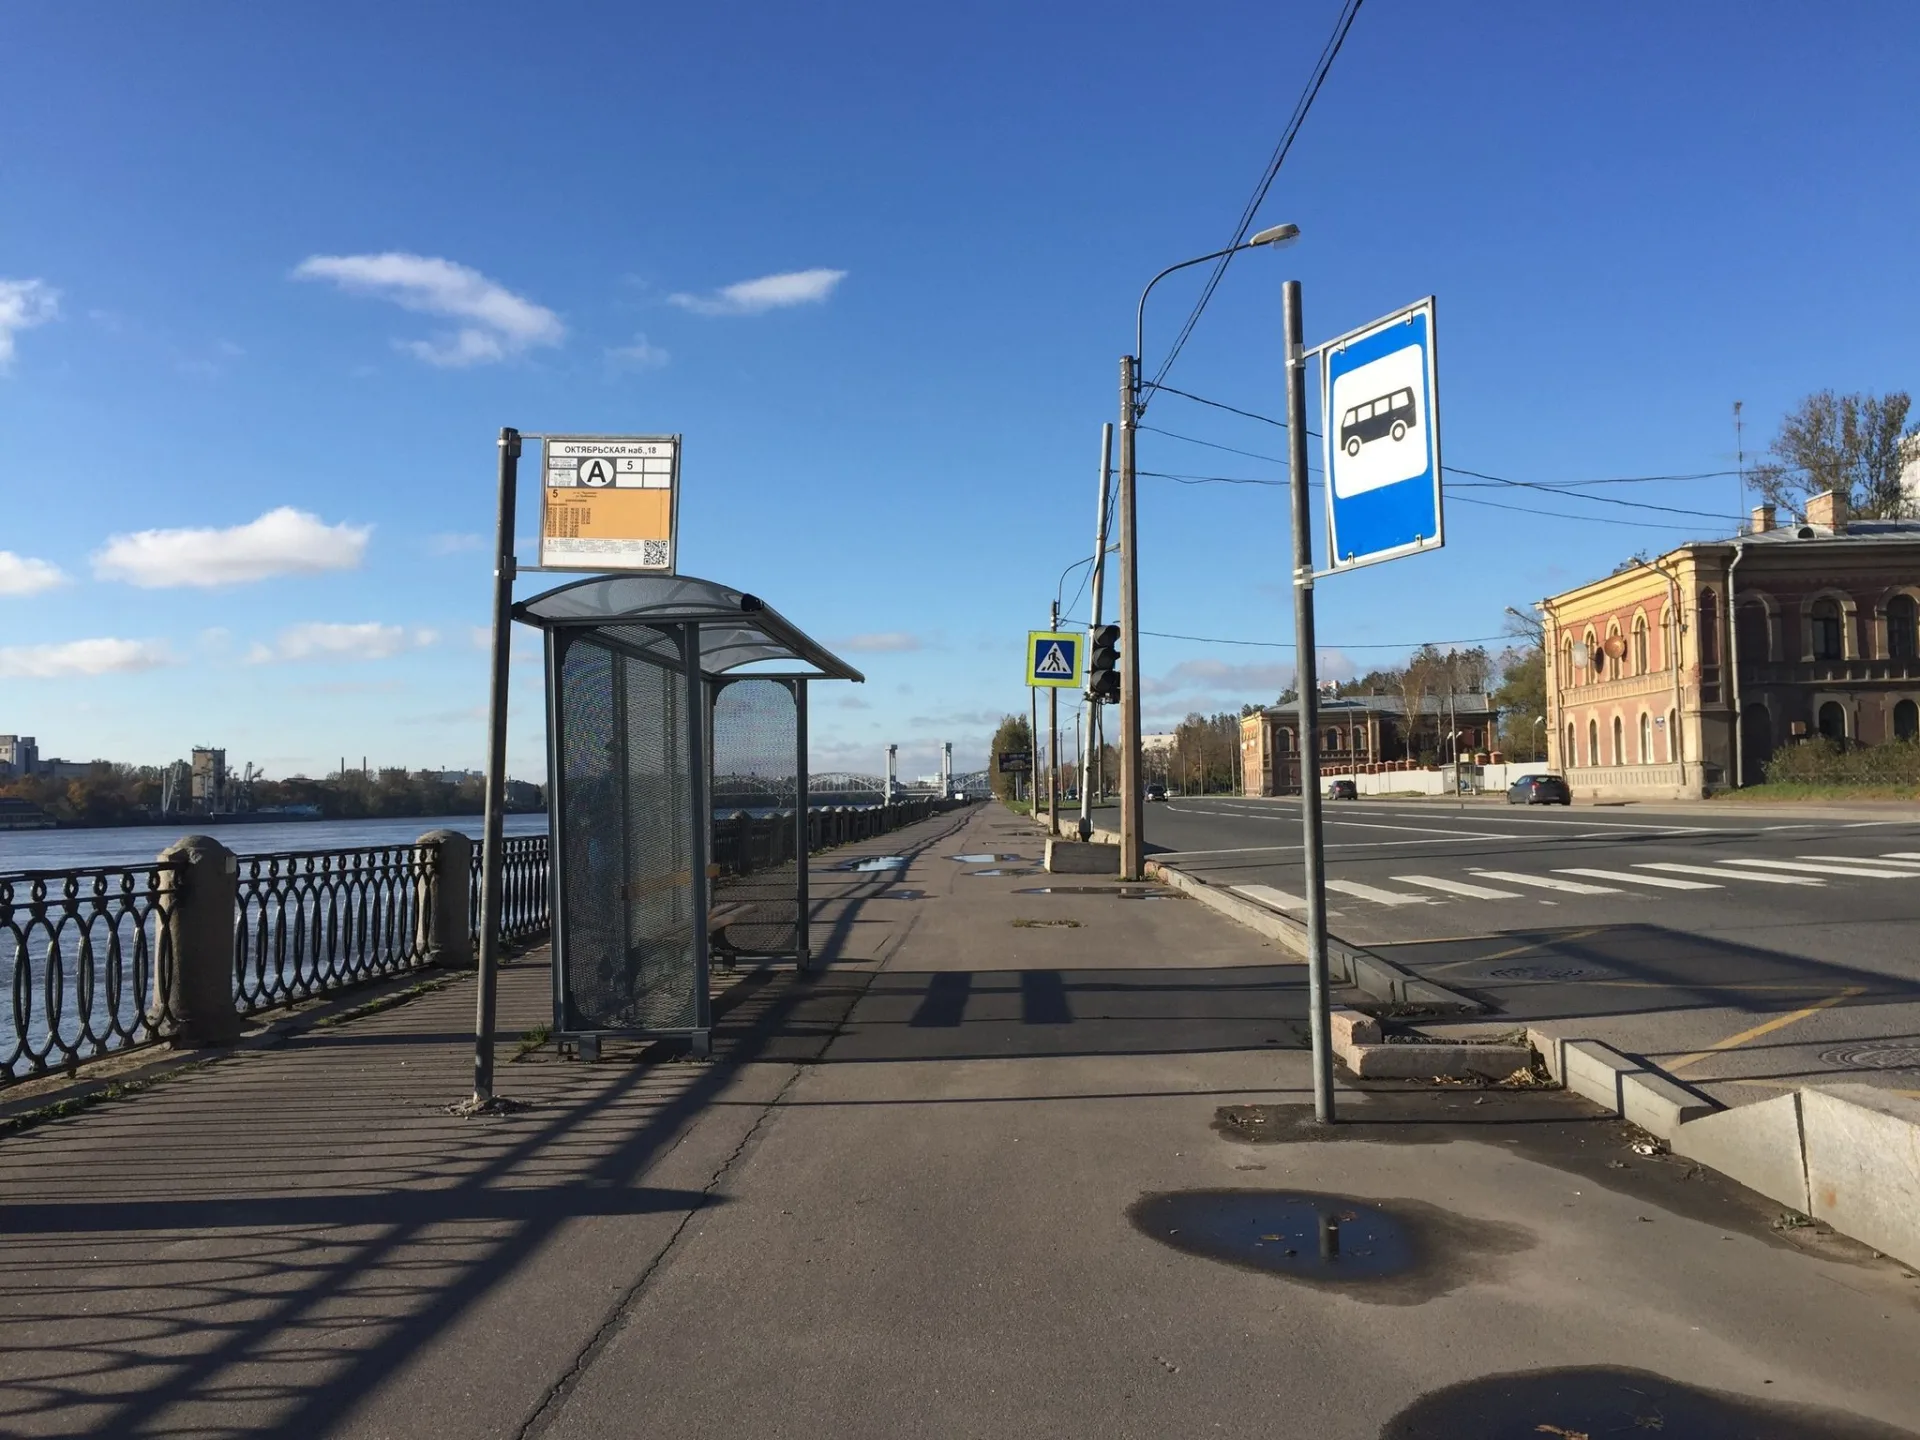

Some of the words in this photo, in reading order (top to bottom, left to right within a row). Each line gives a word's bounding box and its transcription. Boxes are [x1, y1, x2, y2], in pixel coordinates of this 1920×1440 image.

[564, 446, 626, 454] ОКТЯБРЬСКАЯ
[626, 461, 633, 470] 5
[552, 489, 558, 498] 5
